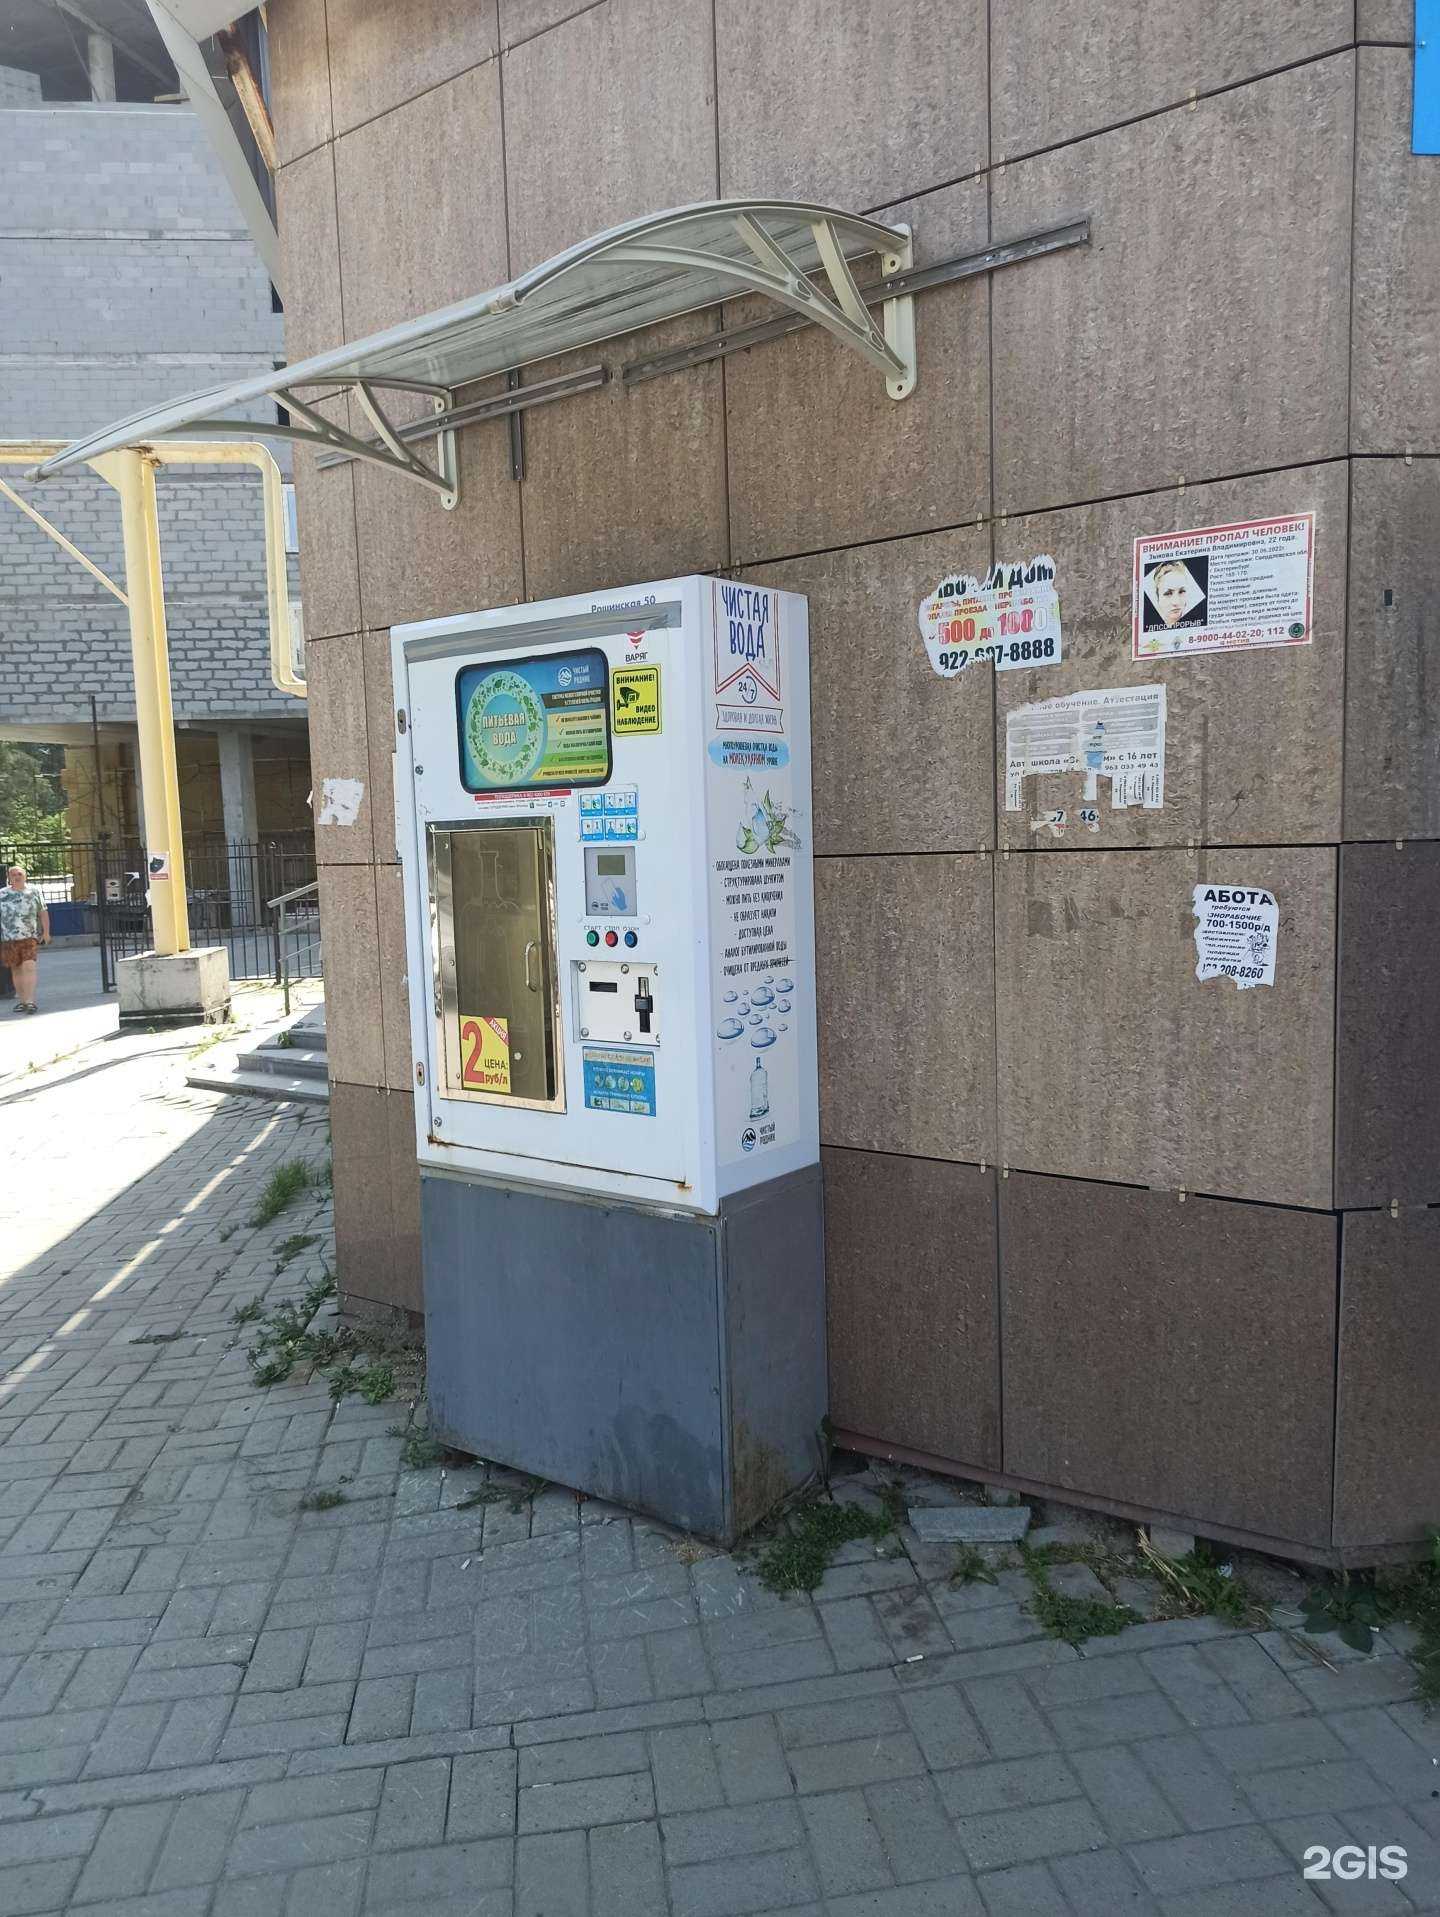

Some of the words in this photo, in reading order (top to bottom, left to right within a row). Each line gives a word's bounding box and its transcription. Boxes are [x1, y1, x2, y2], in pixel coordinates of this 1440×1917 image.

[1143, 538, 1203, 553] ВНИМАНИЕ!
[1206, 531, 1249, 545] ПРОПАЛ
[1252, 522, 1305, 538] ЧЕЛОВЕК!
[644, 595, 656, 606] 50
[721, 585, 769, 623] ЧИСТАЯ
[938, 618, 976, 645] 500
[1267, 626, 1285, 636] 112
[730, 620, 766, 662] ВОДА
[625, 652, 649, 662] ВАРЯГ
[616, 674, 656, 685] ВНИМАНИЕ!
[635, 705, 656, 714] ВИДЕО
[482, 712, 527, 730] ПИТЬЕВАЯ
[616, 716, 657, 726] НАБЛЮДЕНИЕ
[492, 732, 517, 746] ВОДА
[1127, 752, 1137, 760] 16
[1140, 752, 1158, 760] лет
[462, 1021, 485, 1083] 2
[485, 1073, 508, 1086] руб/л
